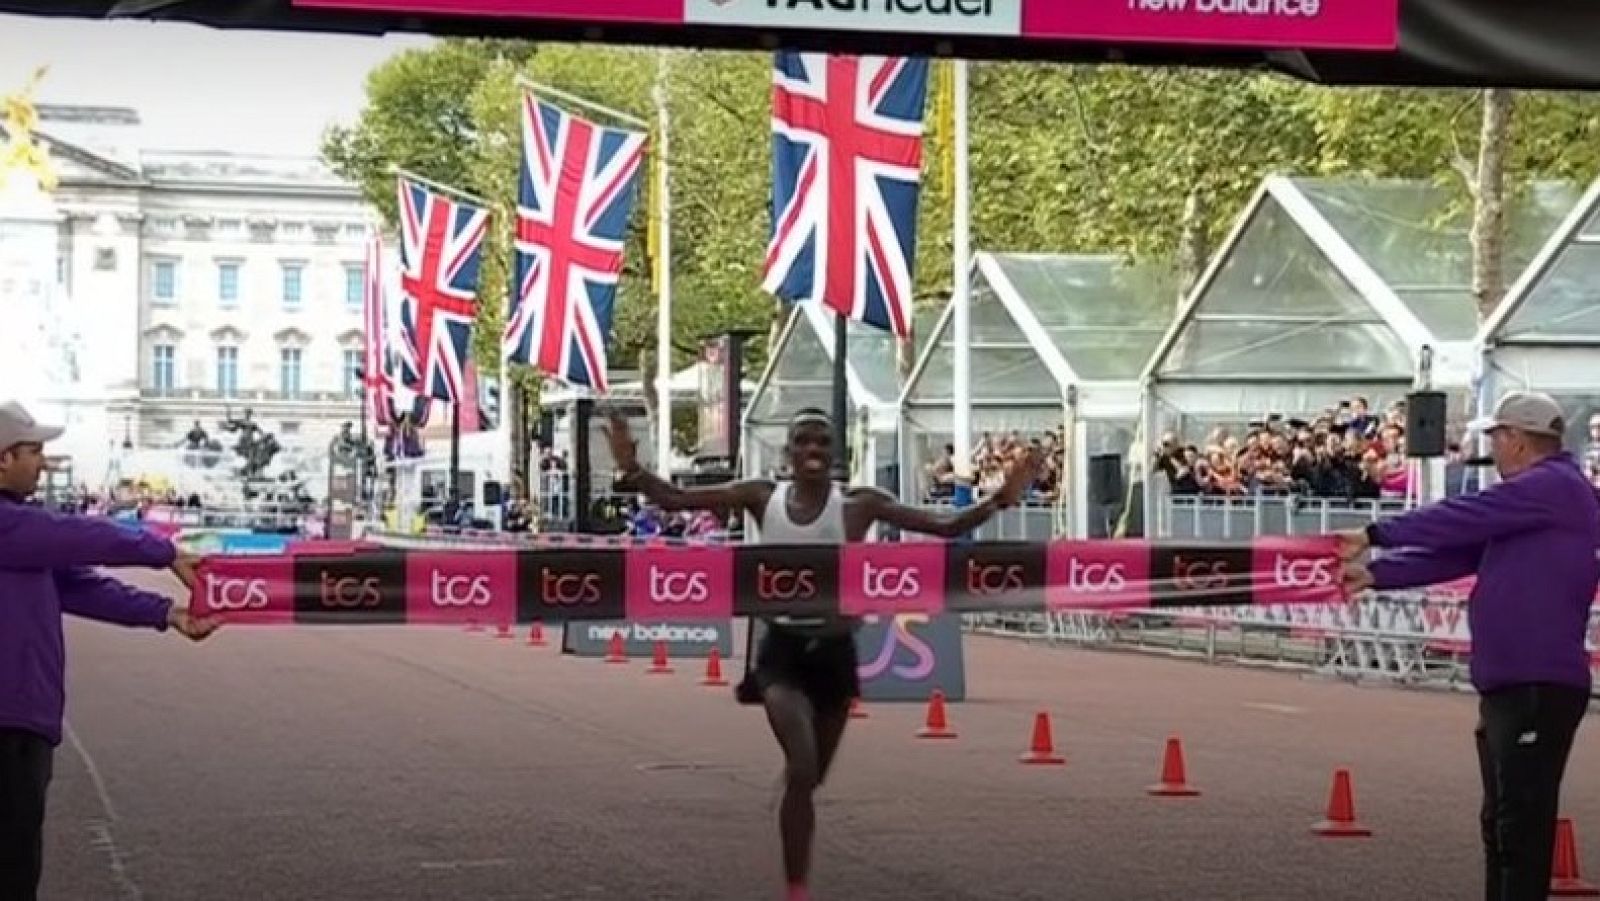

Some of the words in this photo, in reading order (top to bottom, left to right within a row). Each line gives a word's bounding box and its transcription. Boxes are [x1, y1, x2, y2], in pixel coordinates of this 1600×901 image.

[205, 572, 269, 610] tcs
[320, 570, 382, 607] tcs
[431, 568, 492, 607] tcs
[541, 566, 602, 604] tcs
[649, 564, 709, 603] tcs
[757, 562, 817, 599] tcs
[863, 560, 920, 598] tcs
[967, 558, 1025, 595] tcs
[1069, 556, 1126, 593] tcs
[1173, 555, 1229, 590] tcs
[1275, 552, 1335, 587] tcs
[588, 625, 631, 641] new
[634, 622, 719, 642] balance
